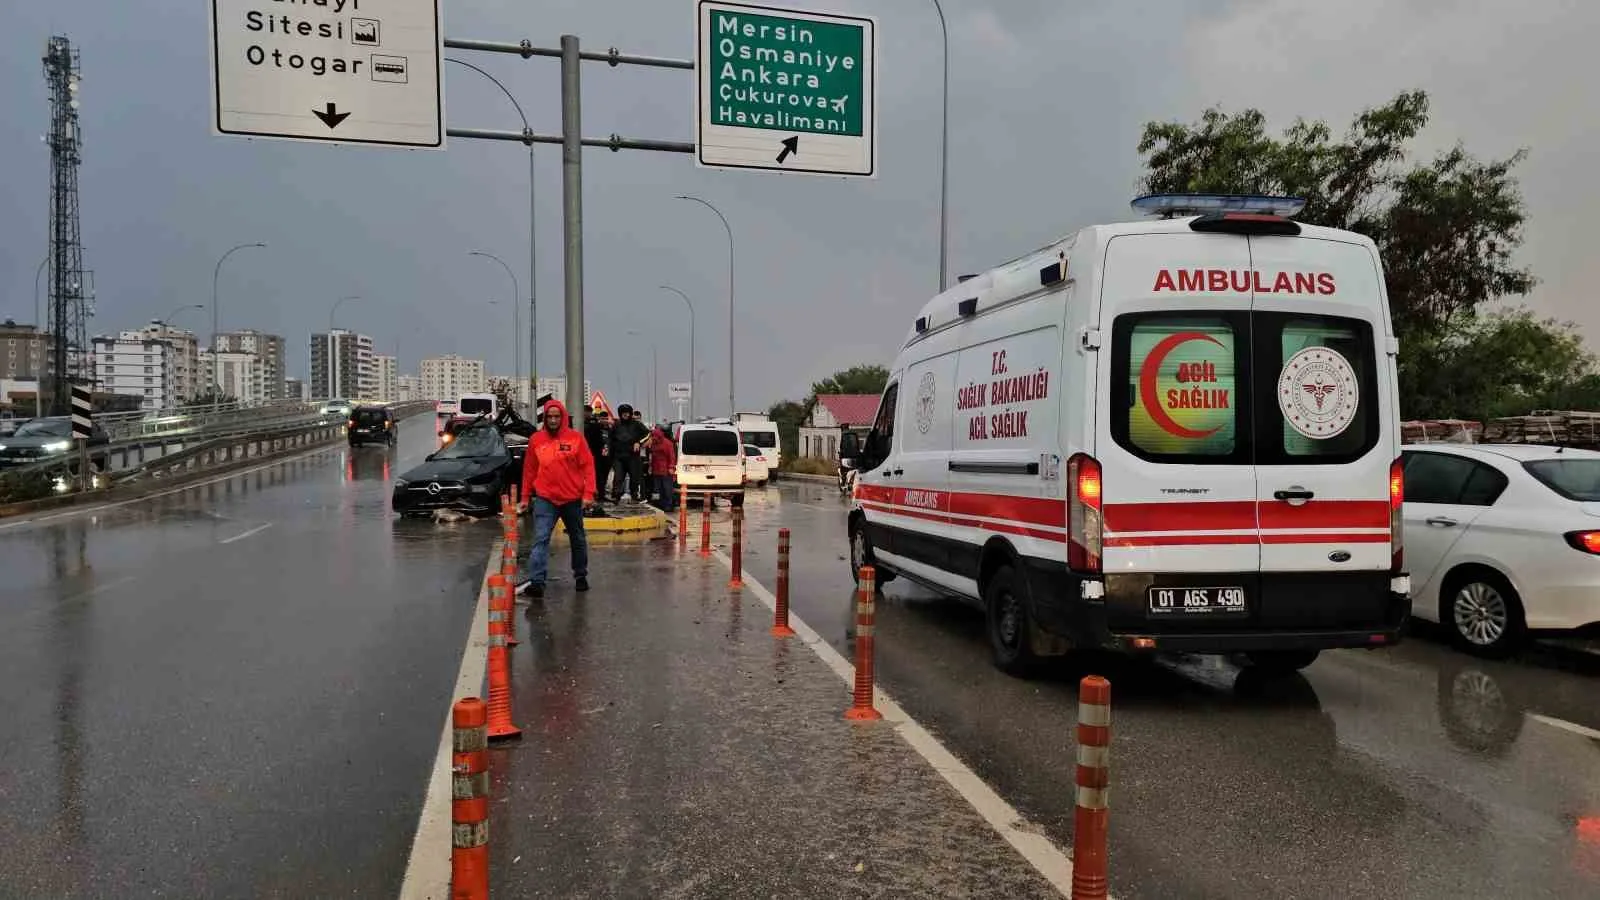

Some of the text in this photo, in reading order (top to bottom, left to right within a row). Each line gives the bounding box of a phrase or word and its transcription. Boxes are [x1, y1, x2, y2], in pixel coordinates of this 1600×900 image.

[246, 10, 342, 39] Sitesi
[719, 16, 813, 43] Mersin
[246, 45, 363, 75] Otogar
[719, 39, 854, 72] Osmaniye
[719, 62, 819, 88] Ankara
[719, 84, 828, 109] Çukurova
[719, 106, 846, 131] Havalimanı
[1152, 269, 1336, 295] AMBULANS
[991, 349, 1008, 376] T.C.
[1177, 360, 1217, 383] ACİL
[957, 366, 1048, 410] SAĞLIK BAKANLIĞI
[1167, 385, 1229, 409] SAĞLIK
[969, 408, 1027, 440] ACİL SAĞLIK
[1158, 589, 1242, 607] 01 AGS 490
